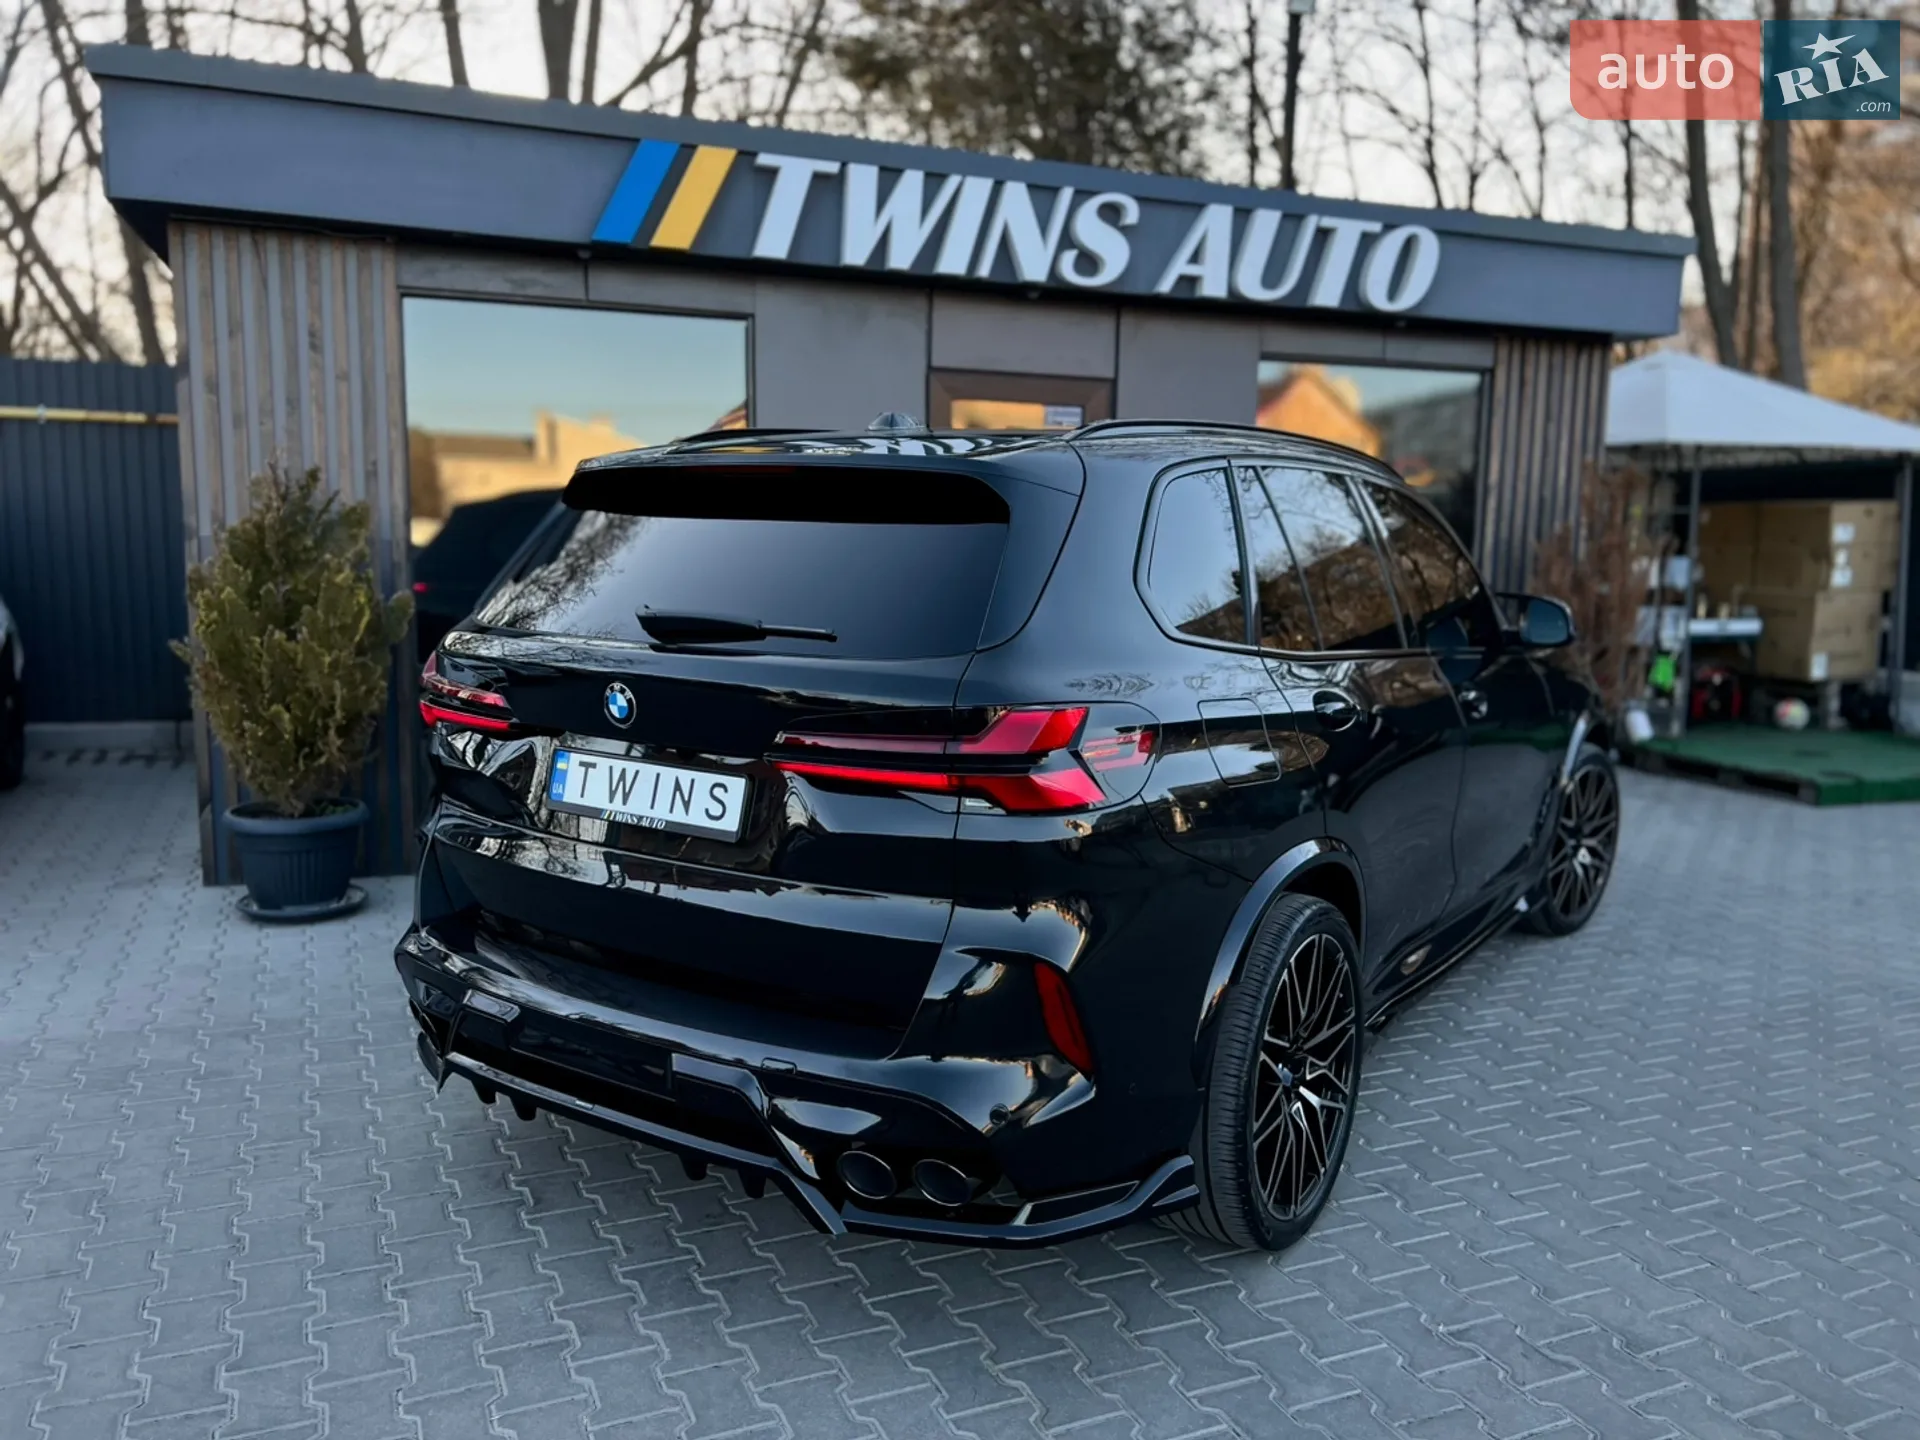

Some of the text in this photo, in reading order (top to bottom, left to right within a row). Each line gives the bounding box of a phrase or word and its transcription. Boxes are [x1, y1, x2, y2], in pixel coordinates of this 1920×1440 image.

[751, 152, 1441, 313] TWINS AUTO
[578, 760, 729, 821] TWINS
[639, 816, 666, 830] AUTO
